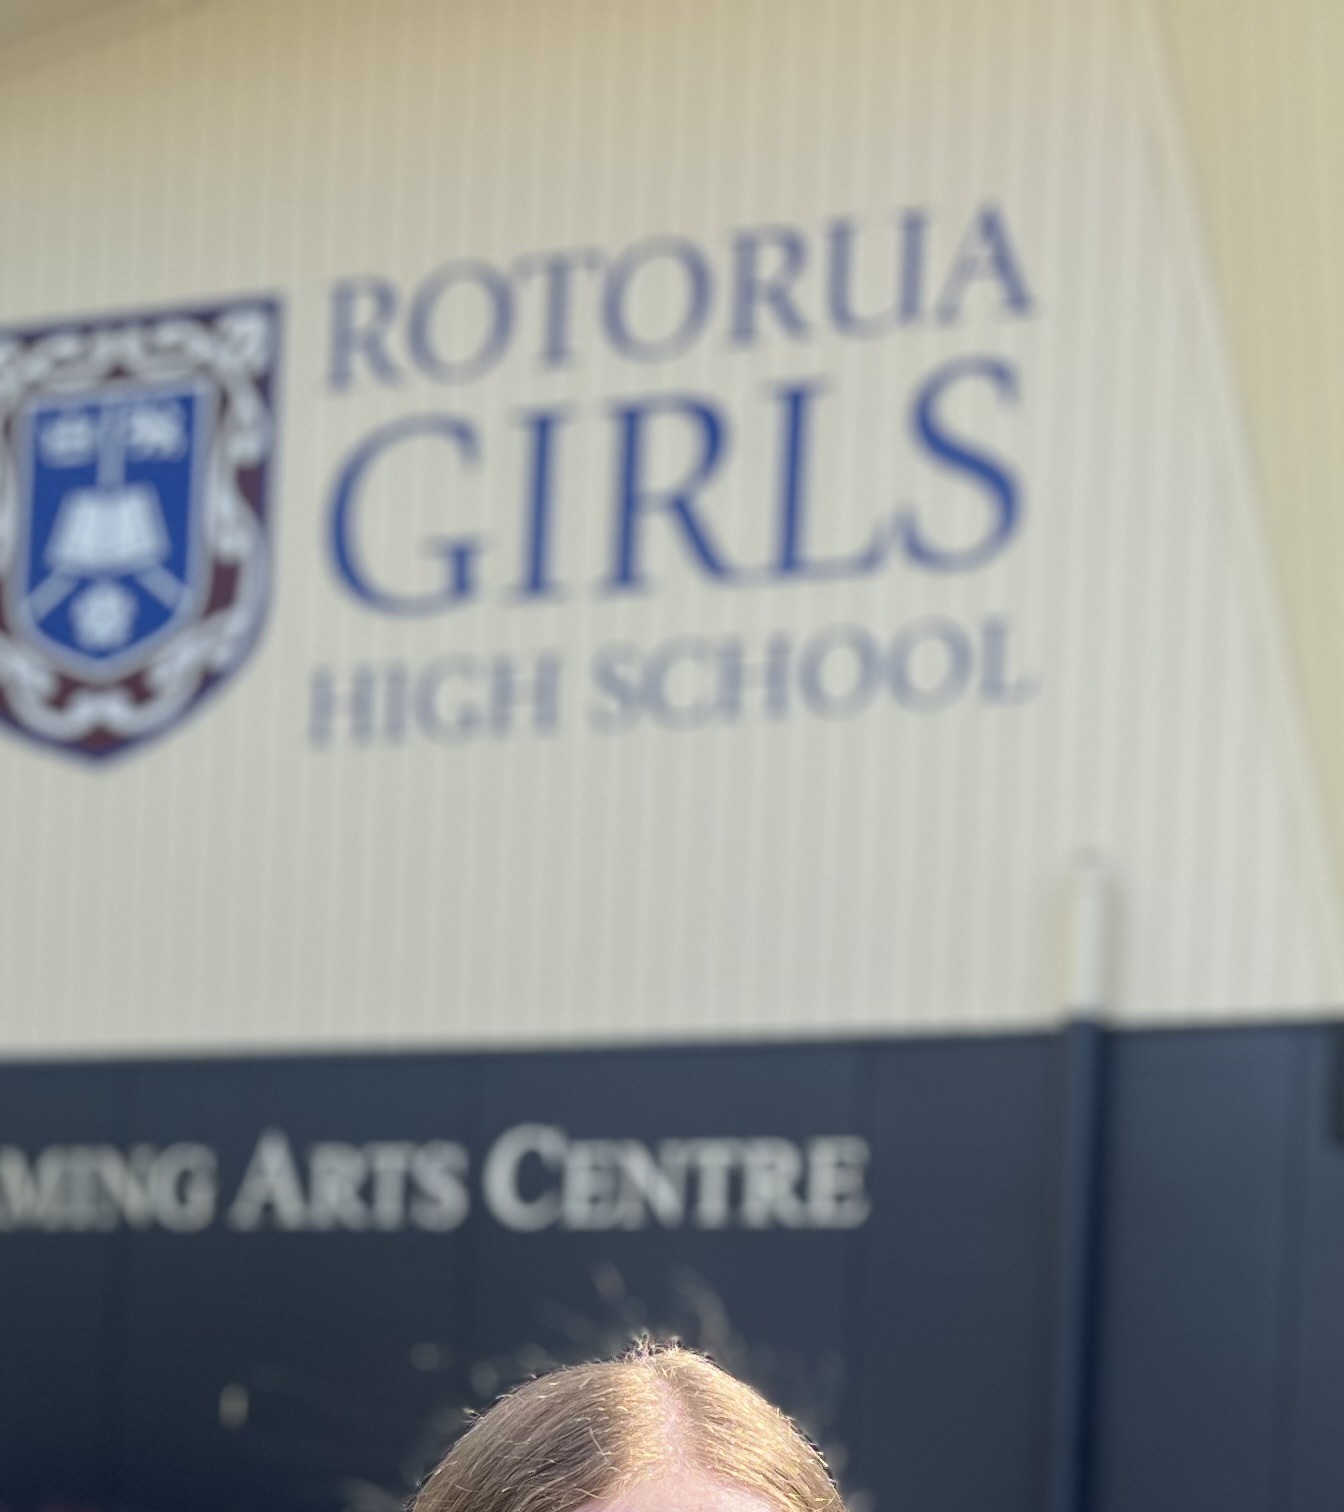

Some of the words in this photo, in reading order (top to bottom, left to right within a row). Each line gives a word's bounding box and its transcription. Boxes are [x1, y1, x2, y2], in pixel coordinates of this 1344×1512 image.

[327, 200, 1037, 391] ROTORUA
[320, 352, 1026, 620] GIRLS
[306, 650, 564, 750] HIGH
[587, 618, 1042, 731] SCHOOL
[225, 1127, 471, 1232] ARTS
[483, 1123, 871, 1232] CENTRE
